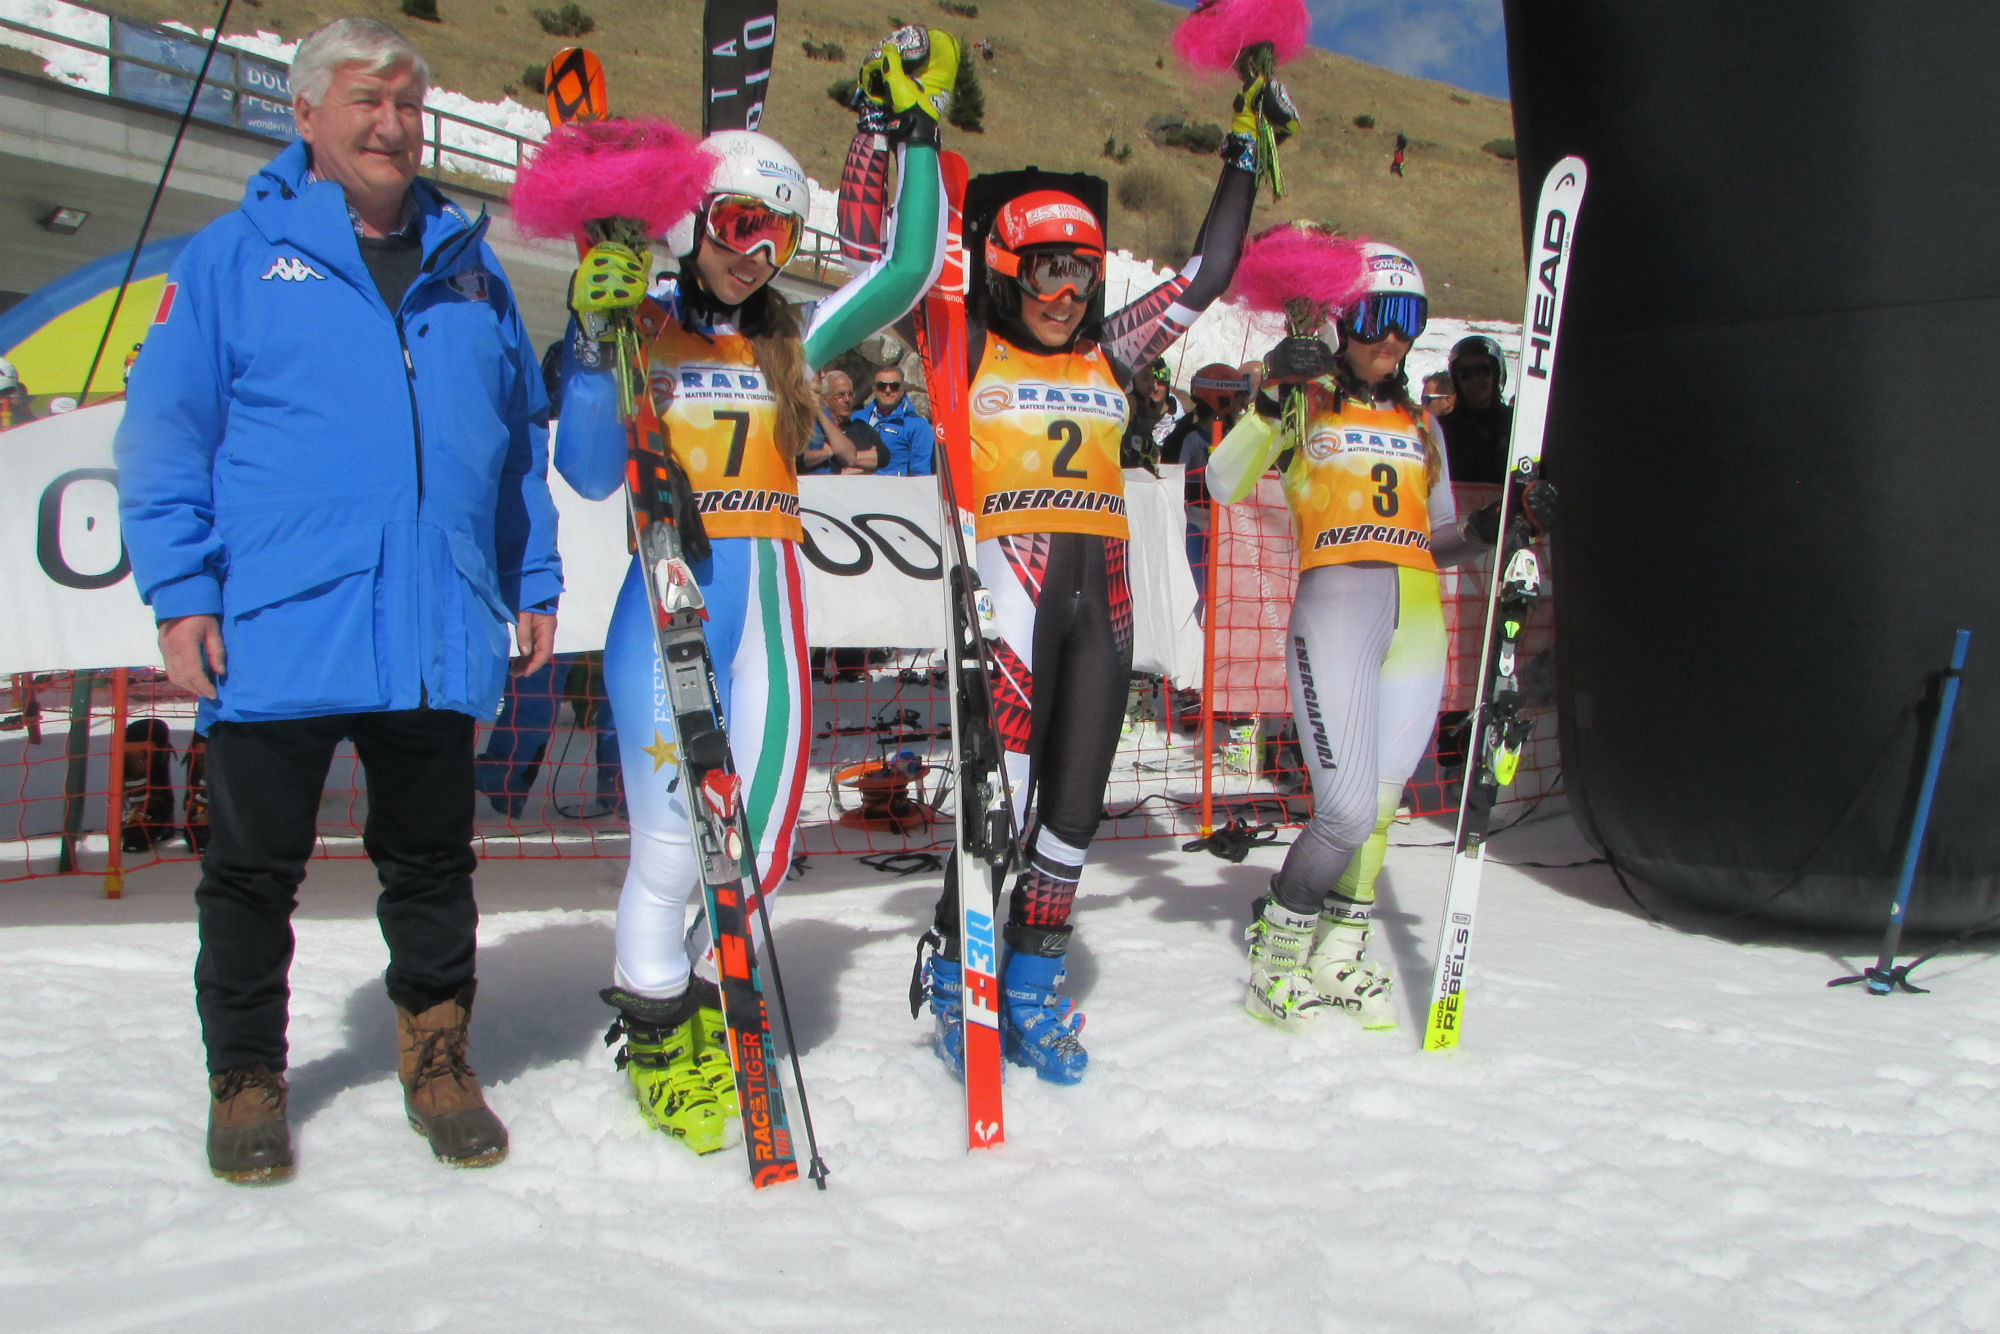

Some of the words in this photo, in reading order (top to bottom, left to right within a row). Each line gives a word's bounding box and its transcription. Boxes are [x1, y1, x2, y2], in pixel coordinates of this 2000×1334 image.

[1527, 208, 1567, 380] HEAD
[685, 391, 712, 399] MATERIE
[714, 391, 732, 399] PRIME
[734, 392, 745, 400] PER
[713, 409, 750, 477] 7
[1046, 419, 1088, 479] 2
[1371, 447, 1385, 455] PRIME
[1385, 449, 1395, 457] PER
[1370, 463, 1399, 518] 3
[1294, 634, 1338, 770] ENERGIAPURA
[1318, 992, 1363, 1012] EAD
[1435, 954, 1451, 1030] WORLDCUP
[1443, 927, 1469, 1031] REBELS
